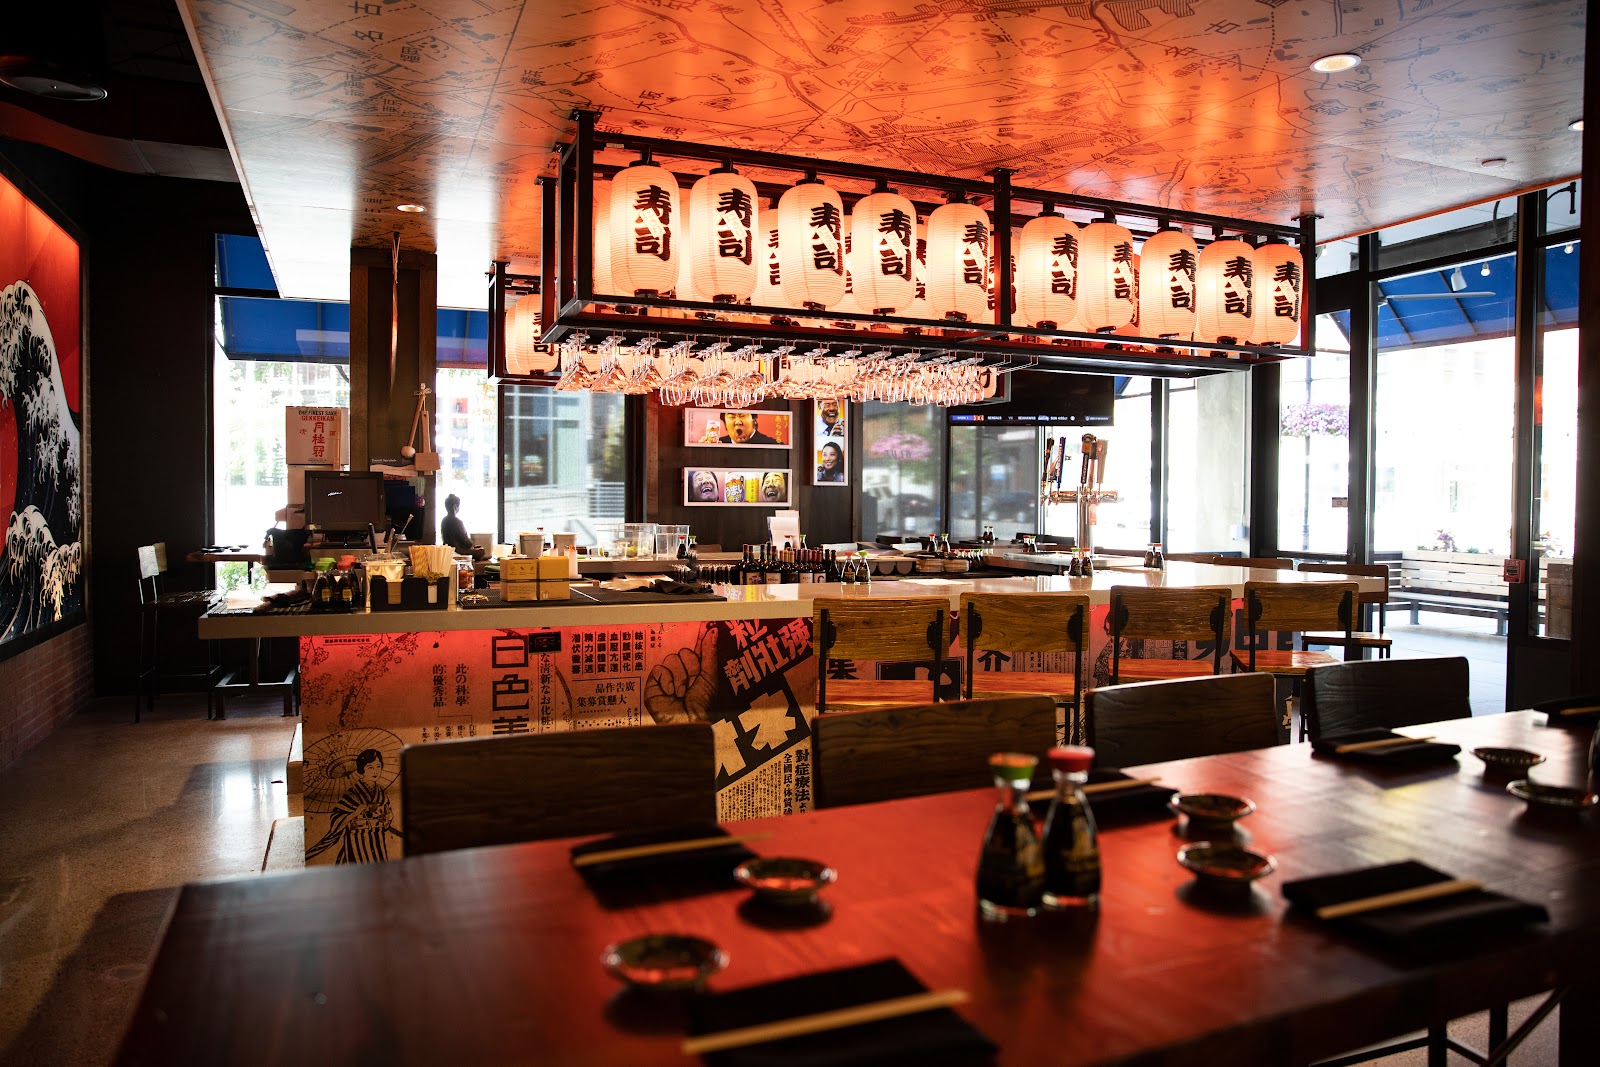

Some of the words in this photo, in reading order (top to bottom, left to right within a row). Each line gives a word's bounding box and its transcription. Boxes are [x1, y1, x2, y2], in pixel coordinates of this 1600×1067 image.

[634, 185, 672, 261] 寿司
[716, 188, 752, 265] 寿司
[810, 202, 843, 276] 寿司
[878, 208, 912, 282] 寿司
[963, 221, 988, 292] 寿司
[1051, 233, 1078, 300] 寿司
[1112, 241, 1134, 304] 寿司
[1168, 249, 1196, 313] 寿司
[1223, 256, 1252, 318] 寿司
[1274, 261, 1300, 322] 寿司
[312, 422, 325, 457] 月桂冠
